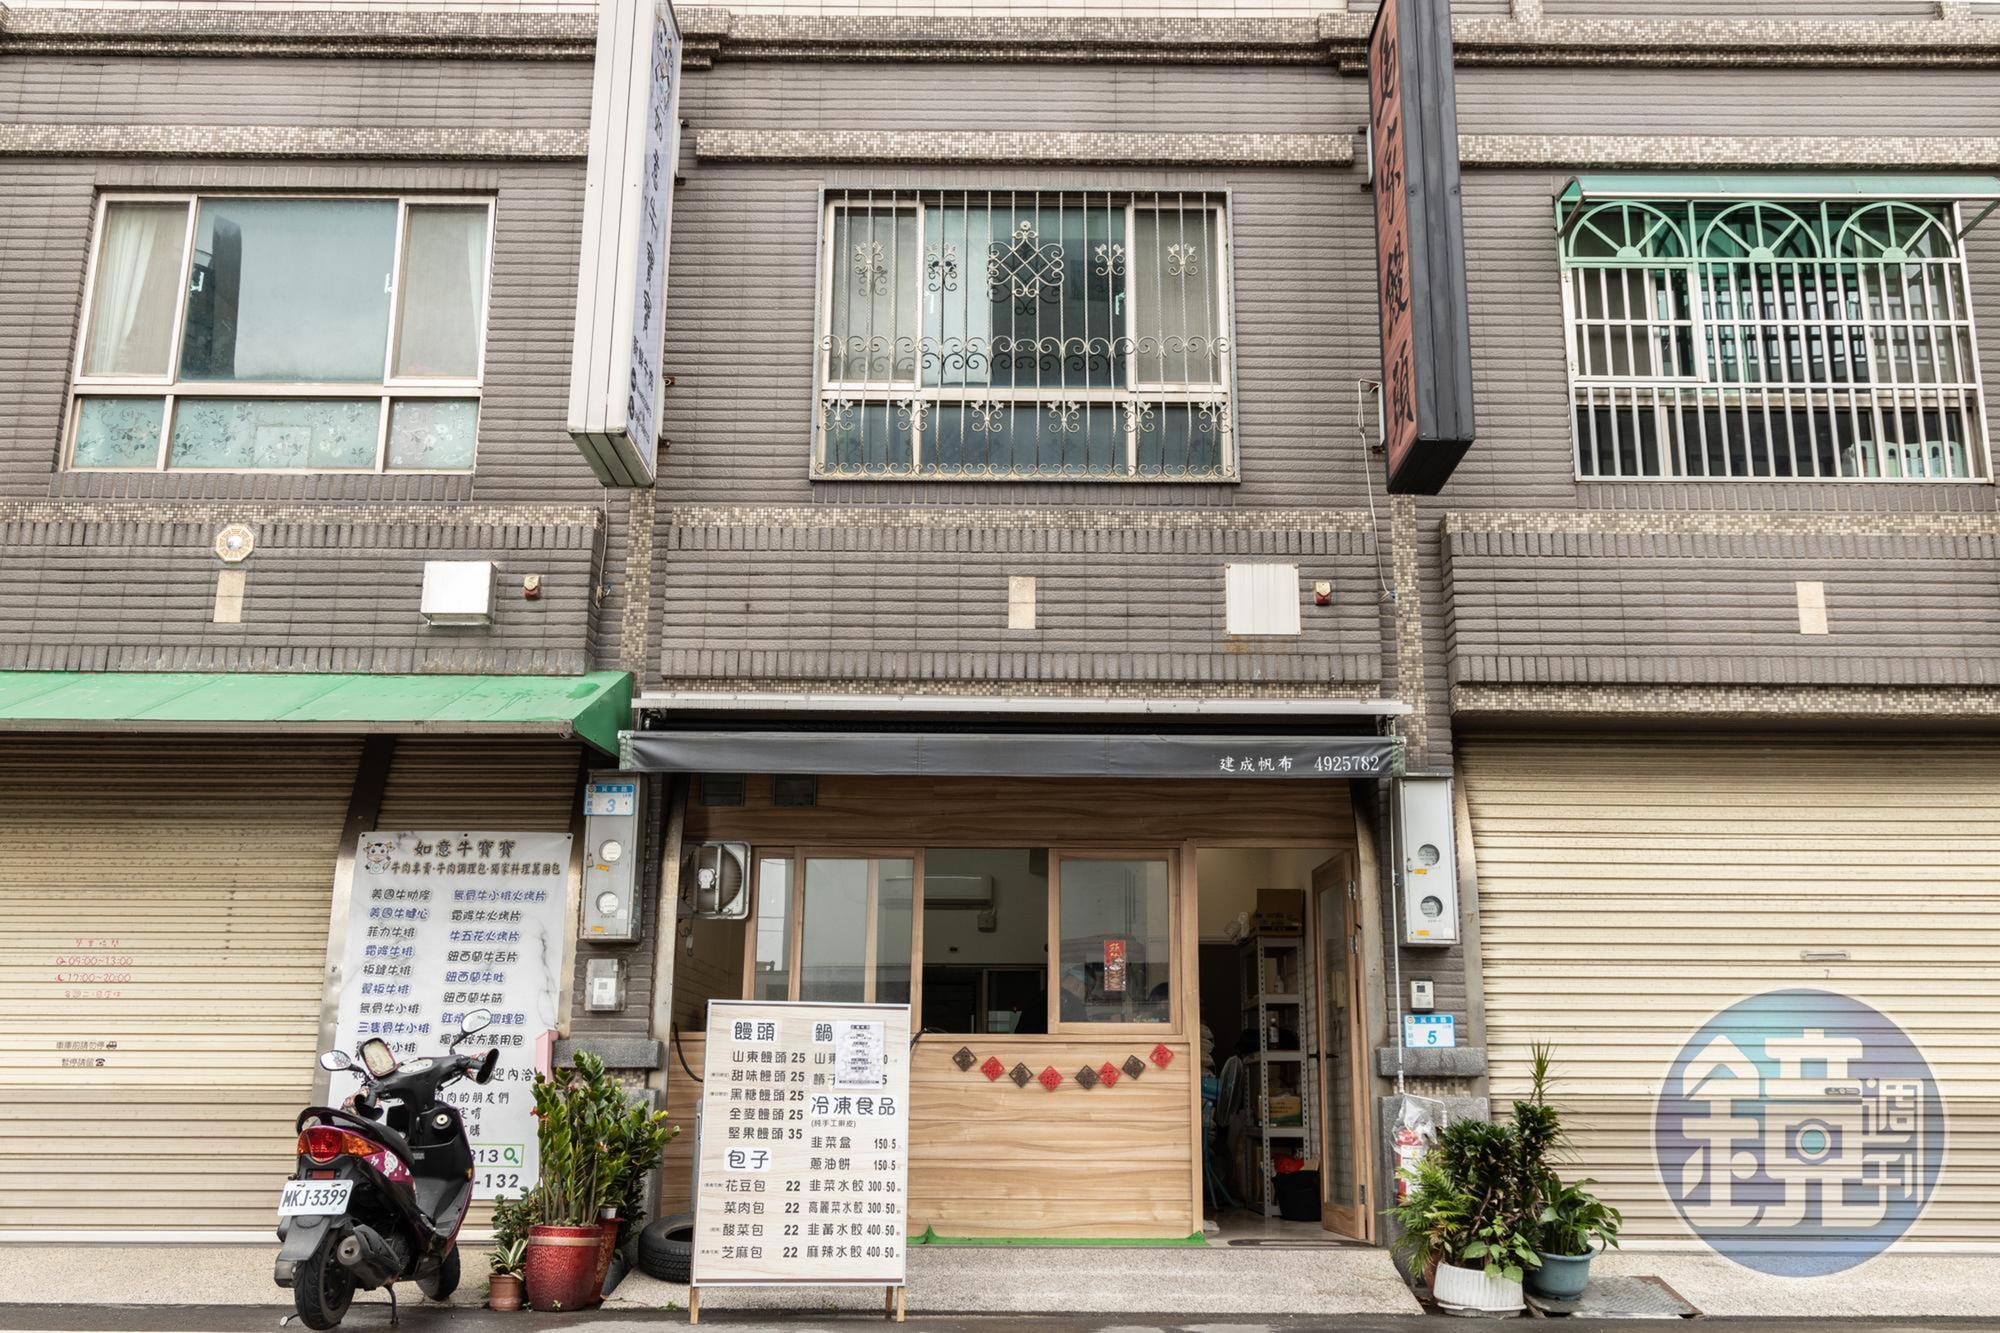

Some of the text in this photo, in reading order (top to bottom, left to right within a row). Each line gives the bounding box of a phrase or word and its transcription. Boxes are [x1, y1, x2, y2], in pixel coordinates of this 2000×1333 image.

[1219, 756, 1379, 772] 建成帆布 4925782
[415, 840, 516, 858] 如意牛寶寶
[366, 926, 416, 938] 菲力牛排
[365, 945, 414, 957] 霜降牛排
[735, 1021, 775, 1041] 饅頭
[1427, 1030, 1437, 1045] 5
[732, 1051, 806, 1064] 山東饅頭 25
[731, 1070, 786, 1083] 甜味饅頭
[791, 1072, 805, 1083] 25
[730, 1088, 785, 1101] 黑糖饅頭
[789, 1090, 805, 1101] 25
[811, 1096, 895, 1116] 冷凍食品
[729, 1107, 803, 1121] 全麥饅頭 25
[728, 1127, 803, 1140] 堅果饅頭 35
[811, 1136, 851, 1149] 韭菜盒
[728, 1150, 769, 1170] 包子
[725, 1179, 766, 1192] 花豆包
[786, 1181, 800, 1192] 22
[810, 1179, 864, 1192] 韭菜水餃
[724, 1201, 799, 1214] 菜肉包 22
[808, 1201, 863, 1214] 高麗菜水餃
[723, 1223, 799, 1237] 酸菜包 22
[721, 1246, 762, 1259] 芝麻包
[783, 1247, 798, 1258] 22
[806, 1246, 862, 1259] 麻辣水餃
